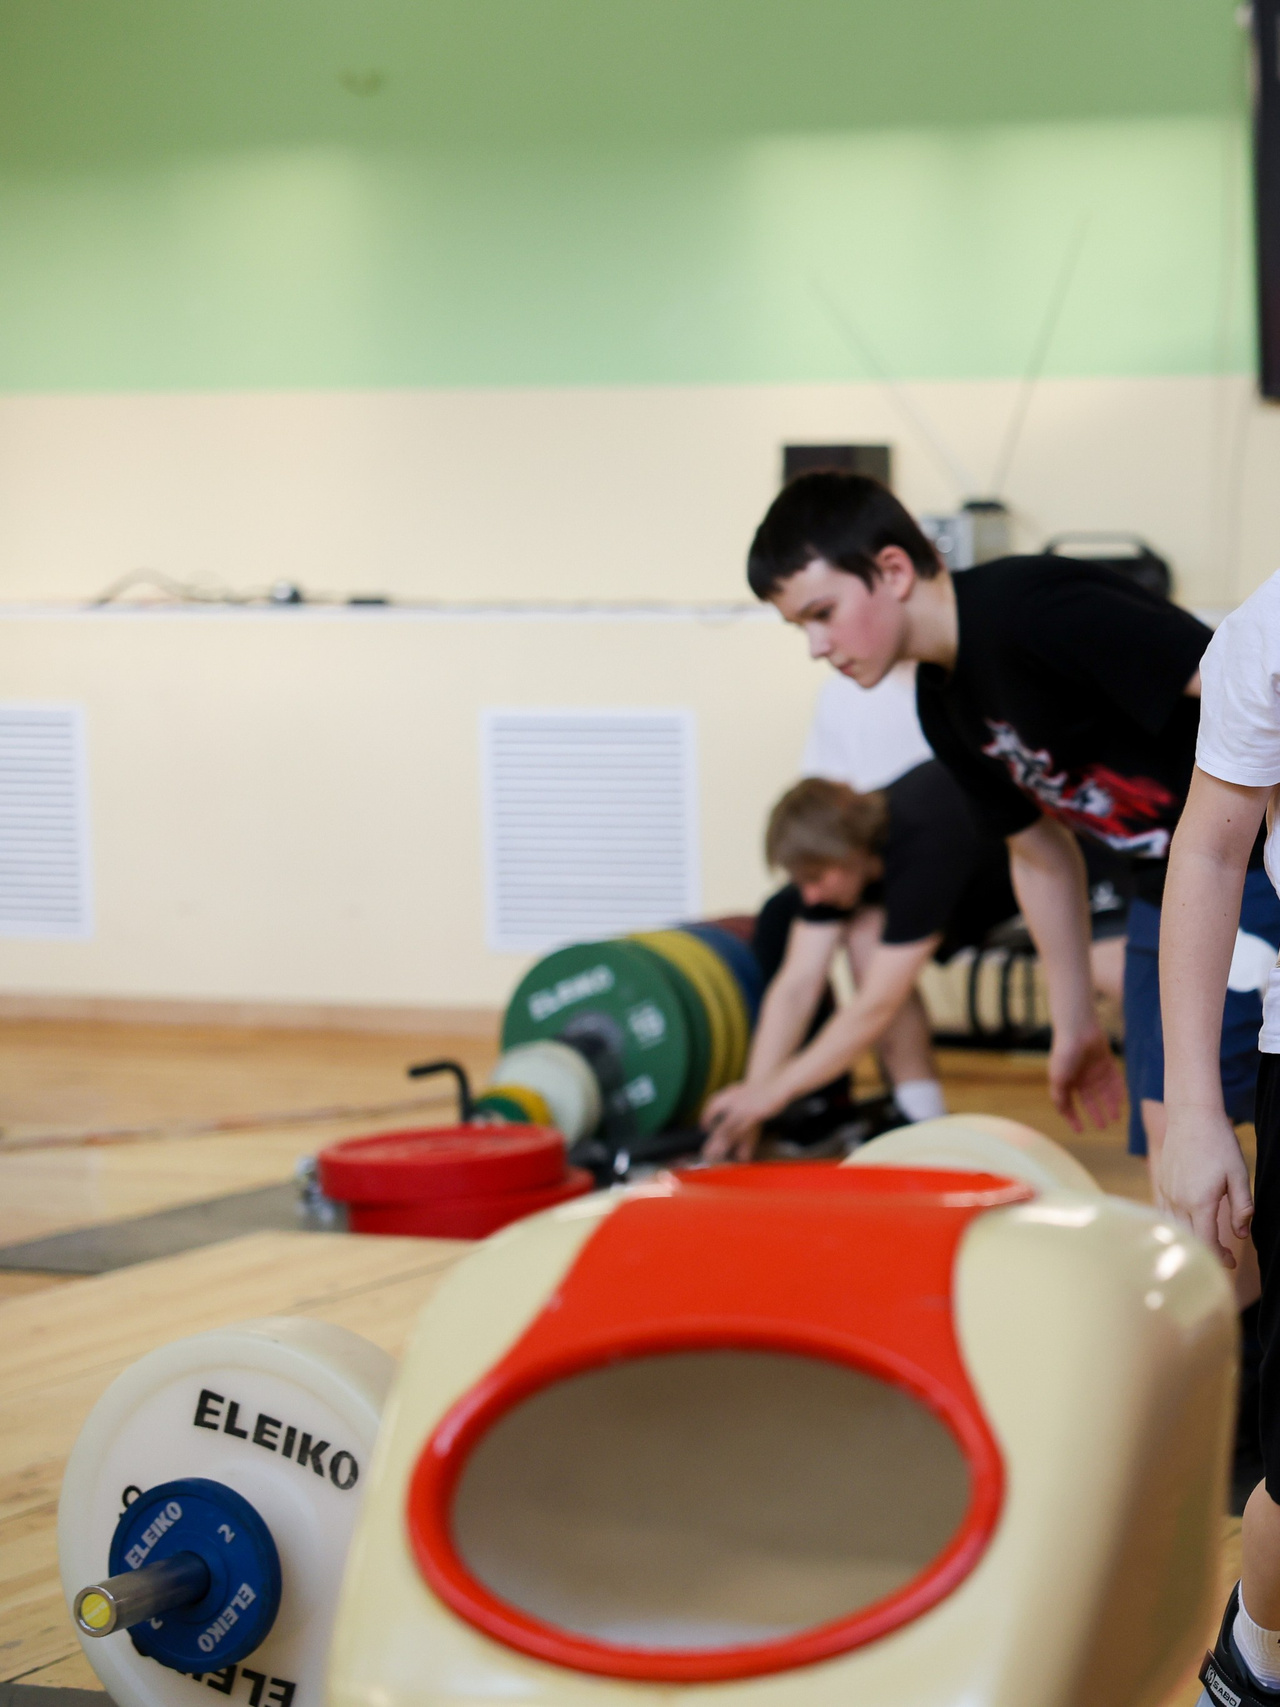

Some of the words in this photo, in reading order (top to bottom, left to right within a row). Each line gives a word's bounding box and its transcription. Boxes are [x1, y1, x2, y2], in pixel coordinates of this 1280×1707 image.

[193, 1388, 360, 1491] ELEIKO
[124, 1501, 183, 1570] ELEIKO
[217, 1523, 236, 1544] 2
[197, 1582, 257, 1653] ELEIKO
[1212, 1680, 1238, 1707] SABO
